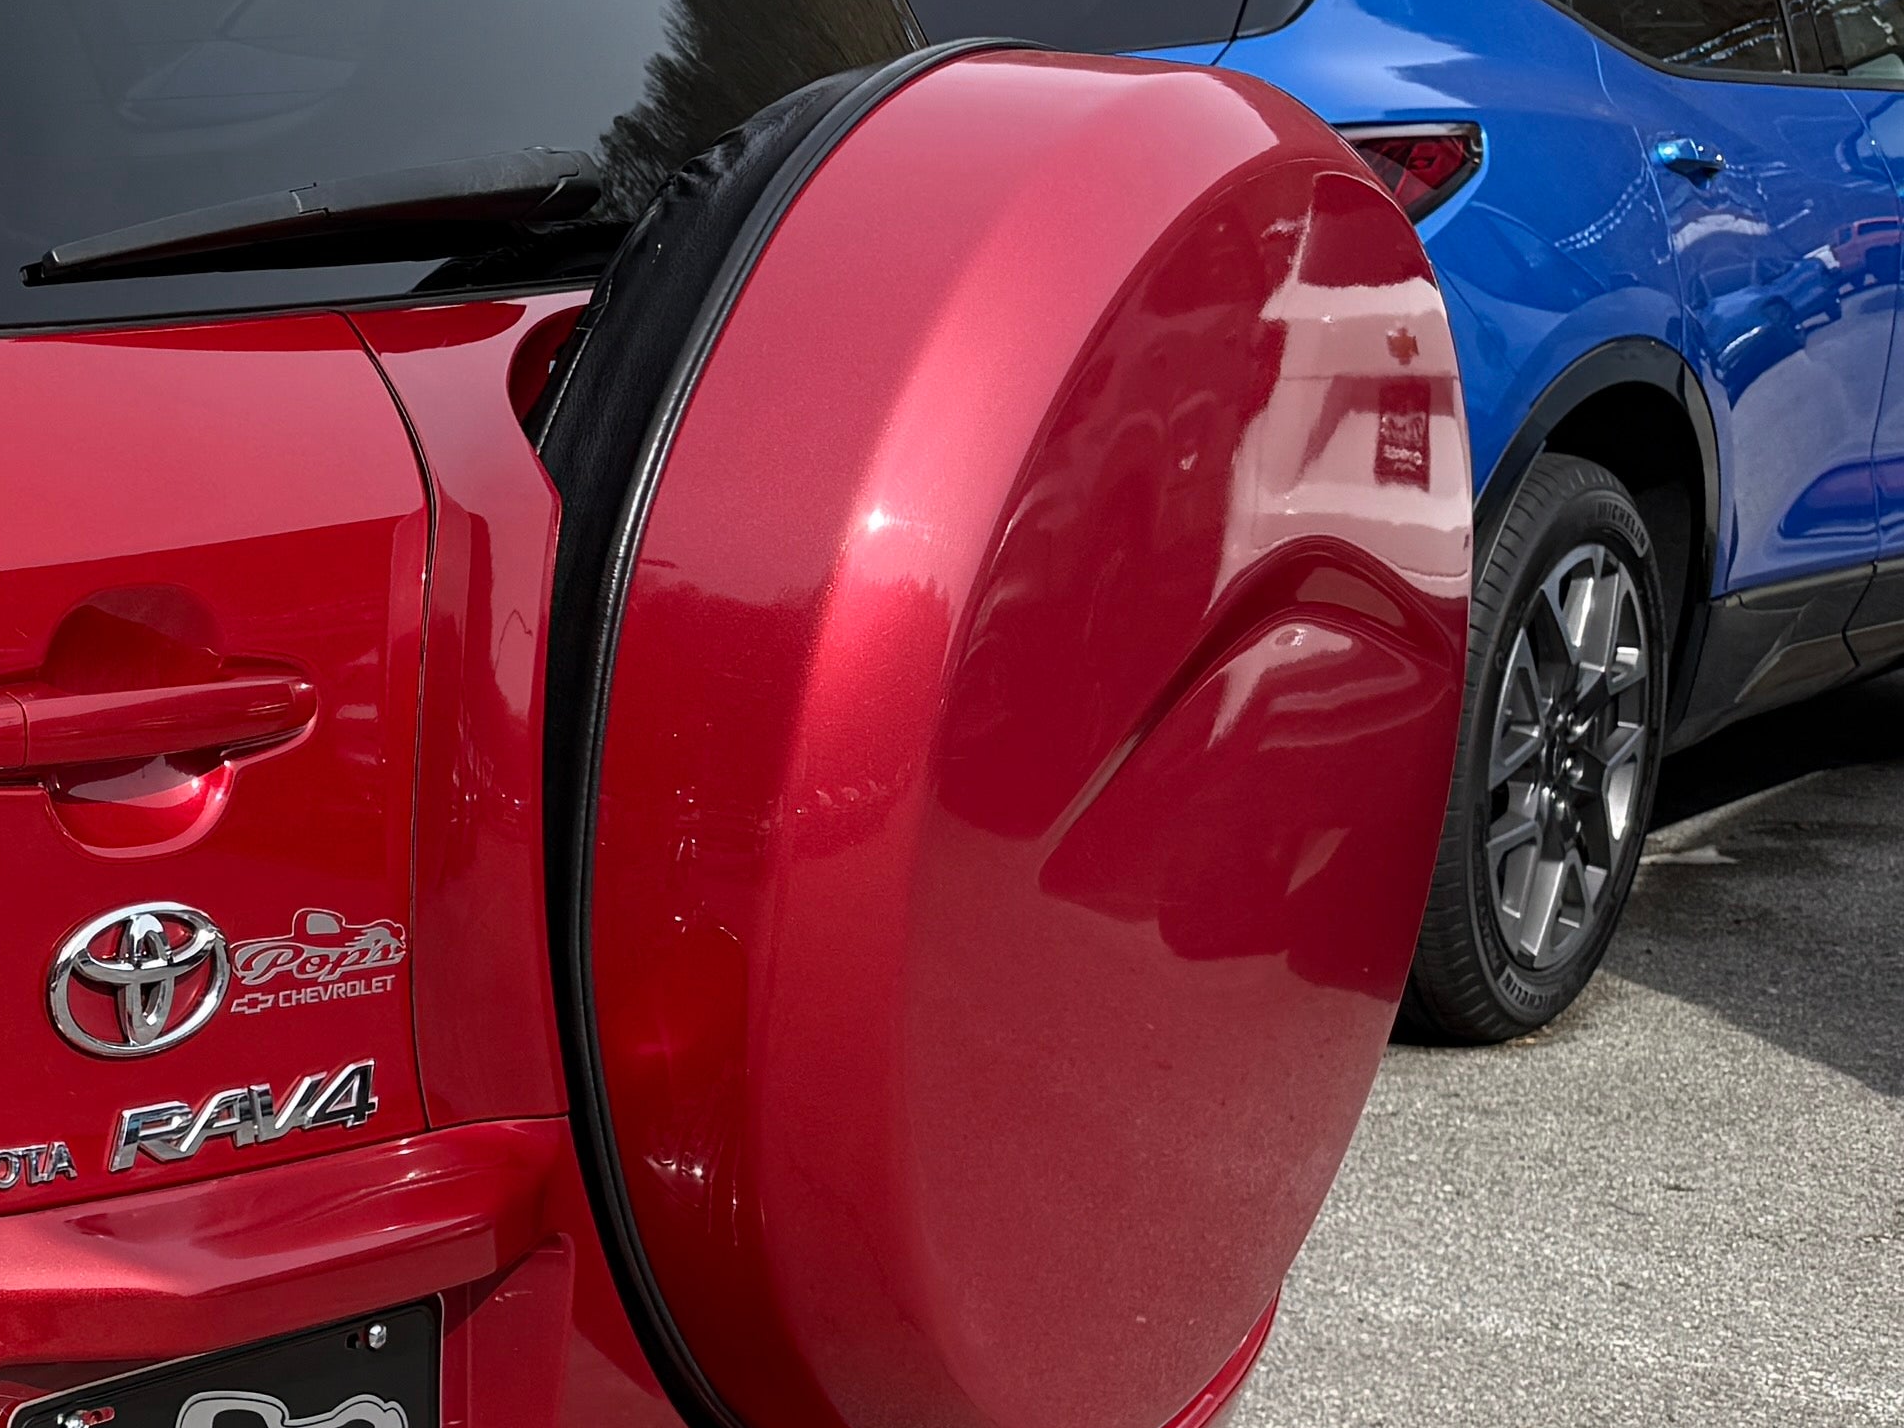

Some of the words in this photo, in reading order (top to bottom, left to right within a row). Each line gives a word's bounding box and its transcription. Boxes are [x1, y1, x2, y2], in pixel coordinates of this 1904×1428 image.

[1597, 501, 1646, 549] MICHELIN
[278, 974, 396, 1008] CHEVROLET
[1501, 972, 1558, 1012] MICHELIN
[108, 1058, 379, 1173] RAV4
